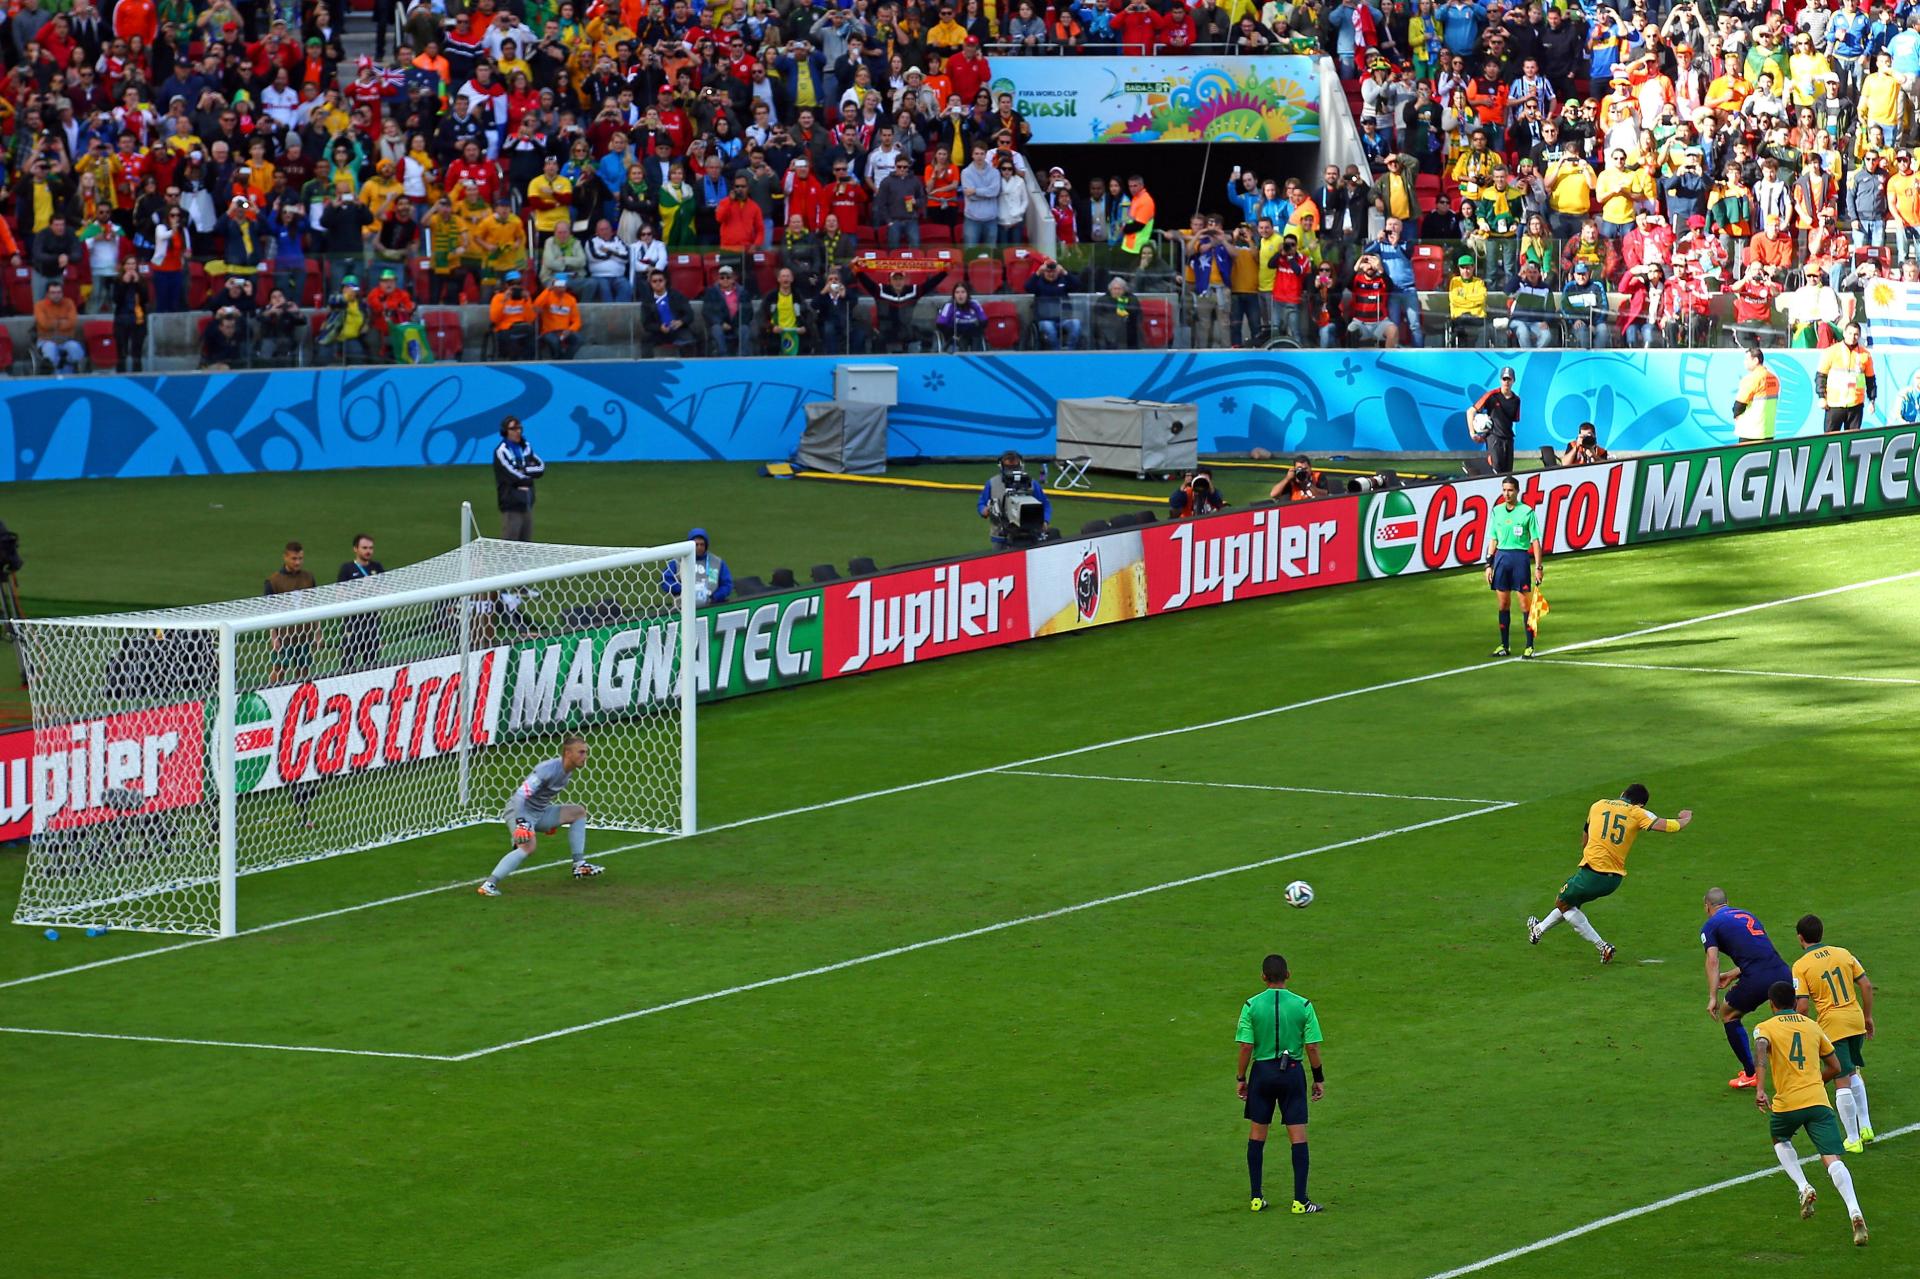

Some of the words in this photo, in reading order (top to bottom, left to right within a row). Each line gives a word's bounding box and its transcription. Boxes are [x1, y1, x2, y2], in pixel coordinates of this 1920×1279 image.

[1016, 98, 1077, 117] Brasil
[1640, 432, 1920, 534] MAGNATE
[1421, 463, 1623, 569] Catrol
[1163, 508, 1338, 610] Jupiler
[839, 565, 1014, 674] Jupiler
[277, 650, 495, 784] Castrol
[1600, 810, 1627, 845] 15
[1734, 913, 1765, 936] 2
[1820, 966, 1850, 1008] 11
[1778, 1015, 1806, 1023] CAHILL
[1788, 1031, 1806, 1070] 4
